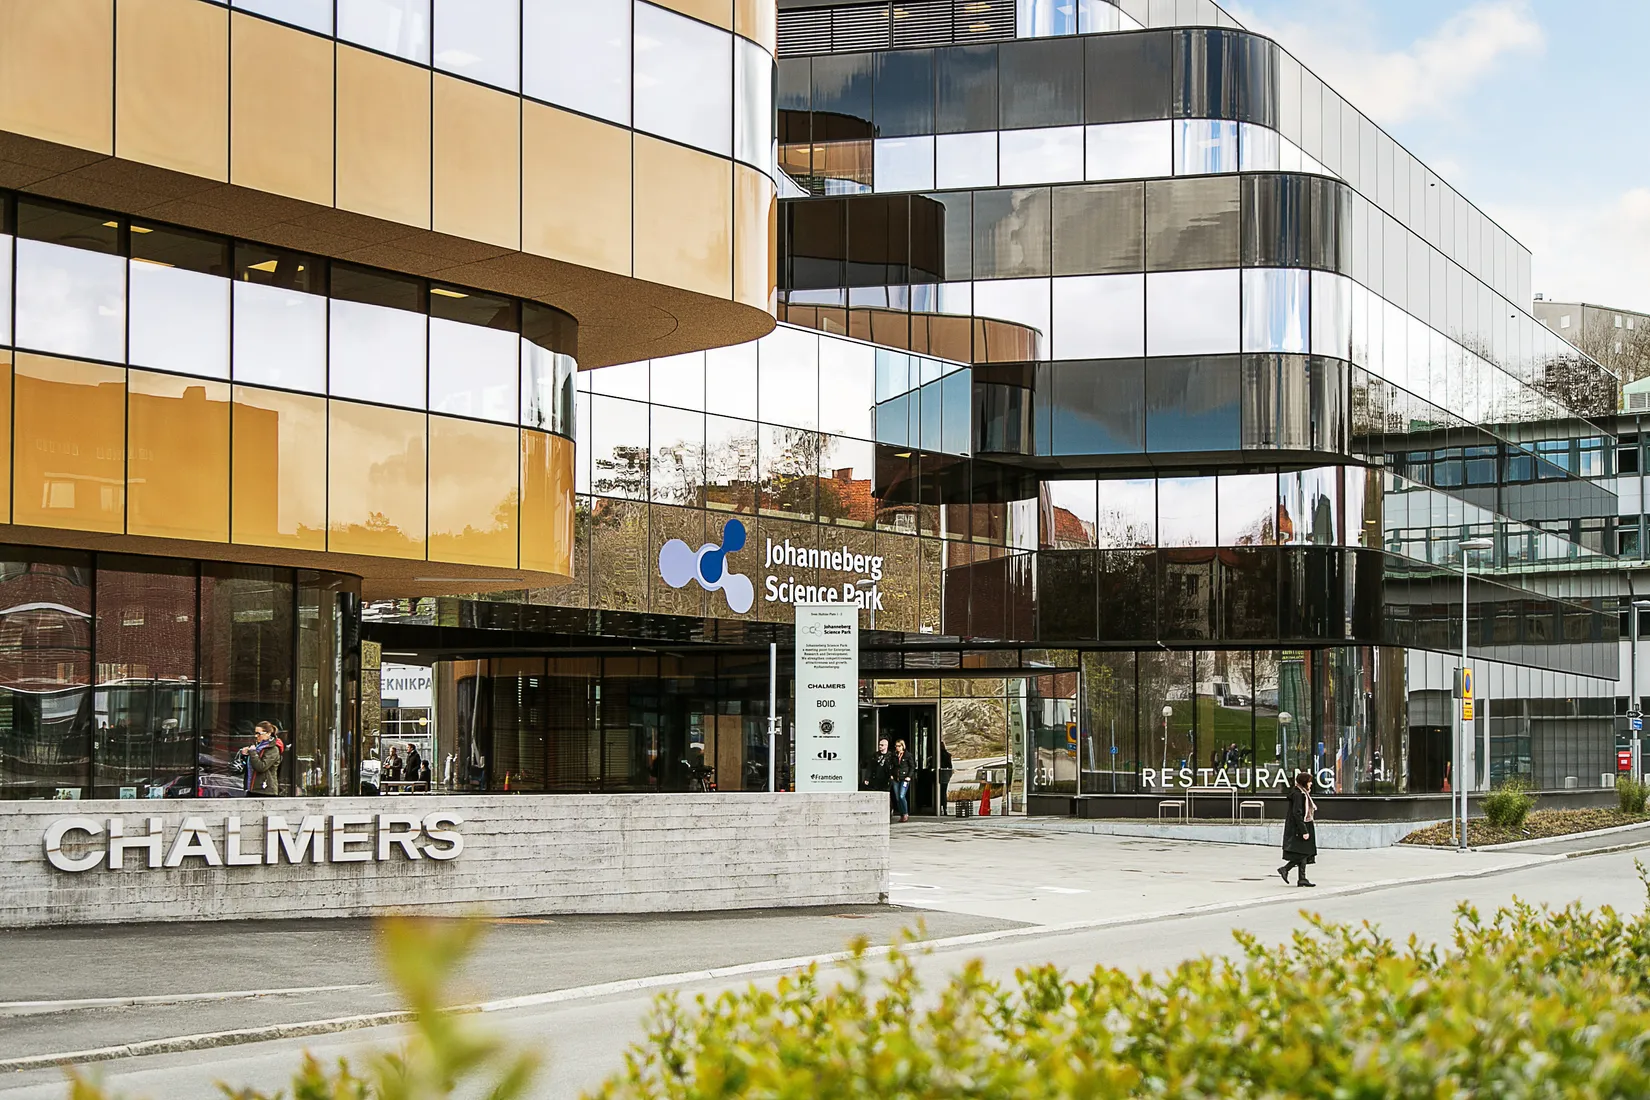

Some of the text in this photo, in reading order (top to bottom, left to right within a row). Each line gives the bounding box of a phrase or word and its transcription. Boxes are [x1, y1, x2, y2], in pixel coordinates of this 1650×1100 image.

[764, 537, 884, 581] Johanneberg
[764, 575, 884, 611] Science Park
[380, 677, 432, 691] EKNIKPA
[43, 811, 465, 872] CHALMERS
